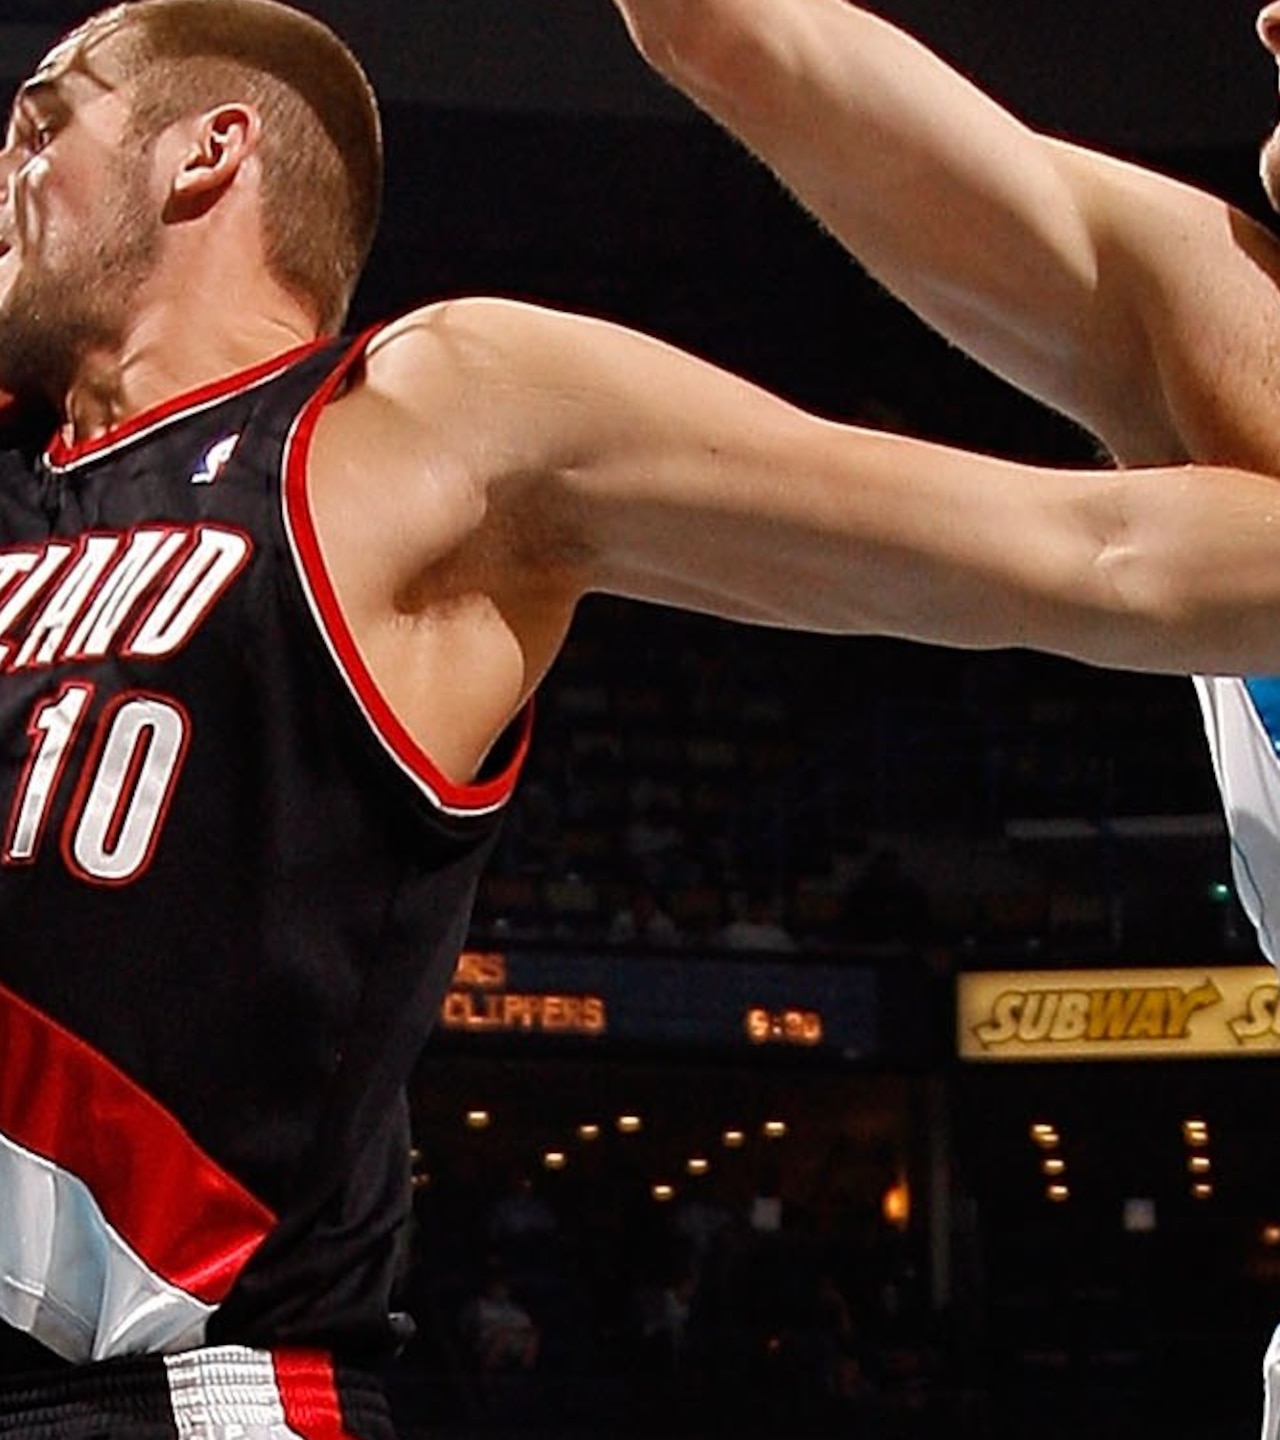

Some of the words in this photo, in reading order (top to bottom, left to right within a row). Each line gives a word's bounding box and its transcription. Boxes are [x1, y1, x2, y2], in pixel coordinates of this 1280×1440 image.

[6, 683, 188, 882] 10
[442, 990, 608, 1036] CLIPPERS
[972, 976, 1223, 1051] SUBWAY
